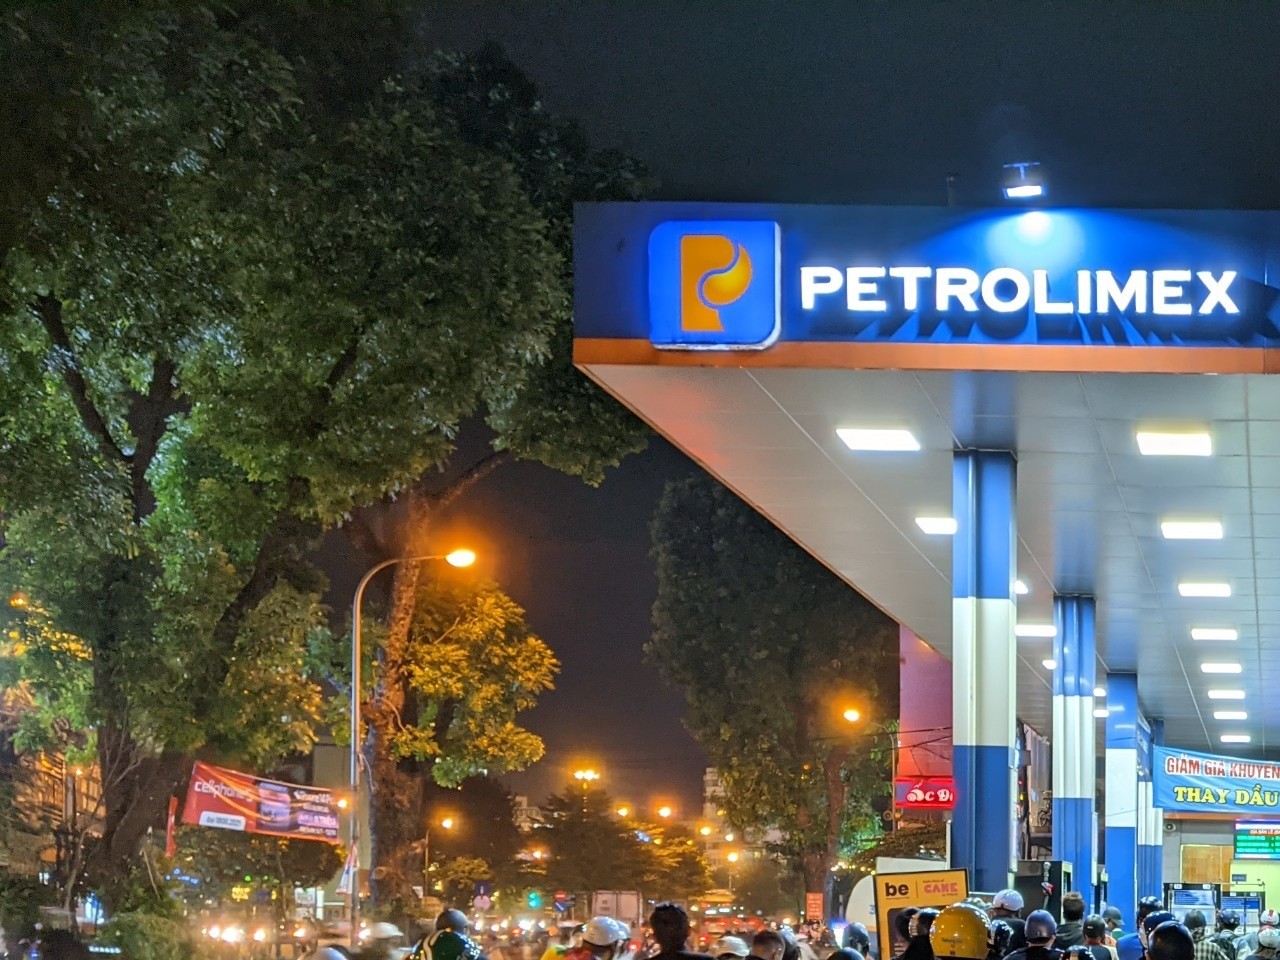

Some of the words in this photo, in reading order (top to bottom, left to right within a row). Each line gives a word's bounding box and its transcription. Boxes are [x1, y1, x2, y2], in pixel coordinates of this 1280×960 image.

[800, 266, 1241, 314] PETROLIMEX
[1229, 762, 1280, 779] KHUYẾN
[1174, 786, 1230, 805] THAY
[1235, 784, 1279, 806] DẦU
[885, 882, 909, 897] be
